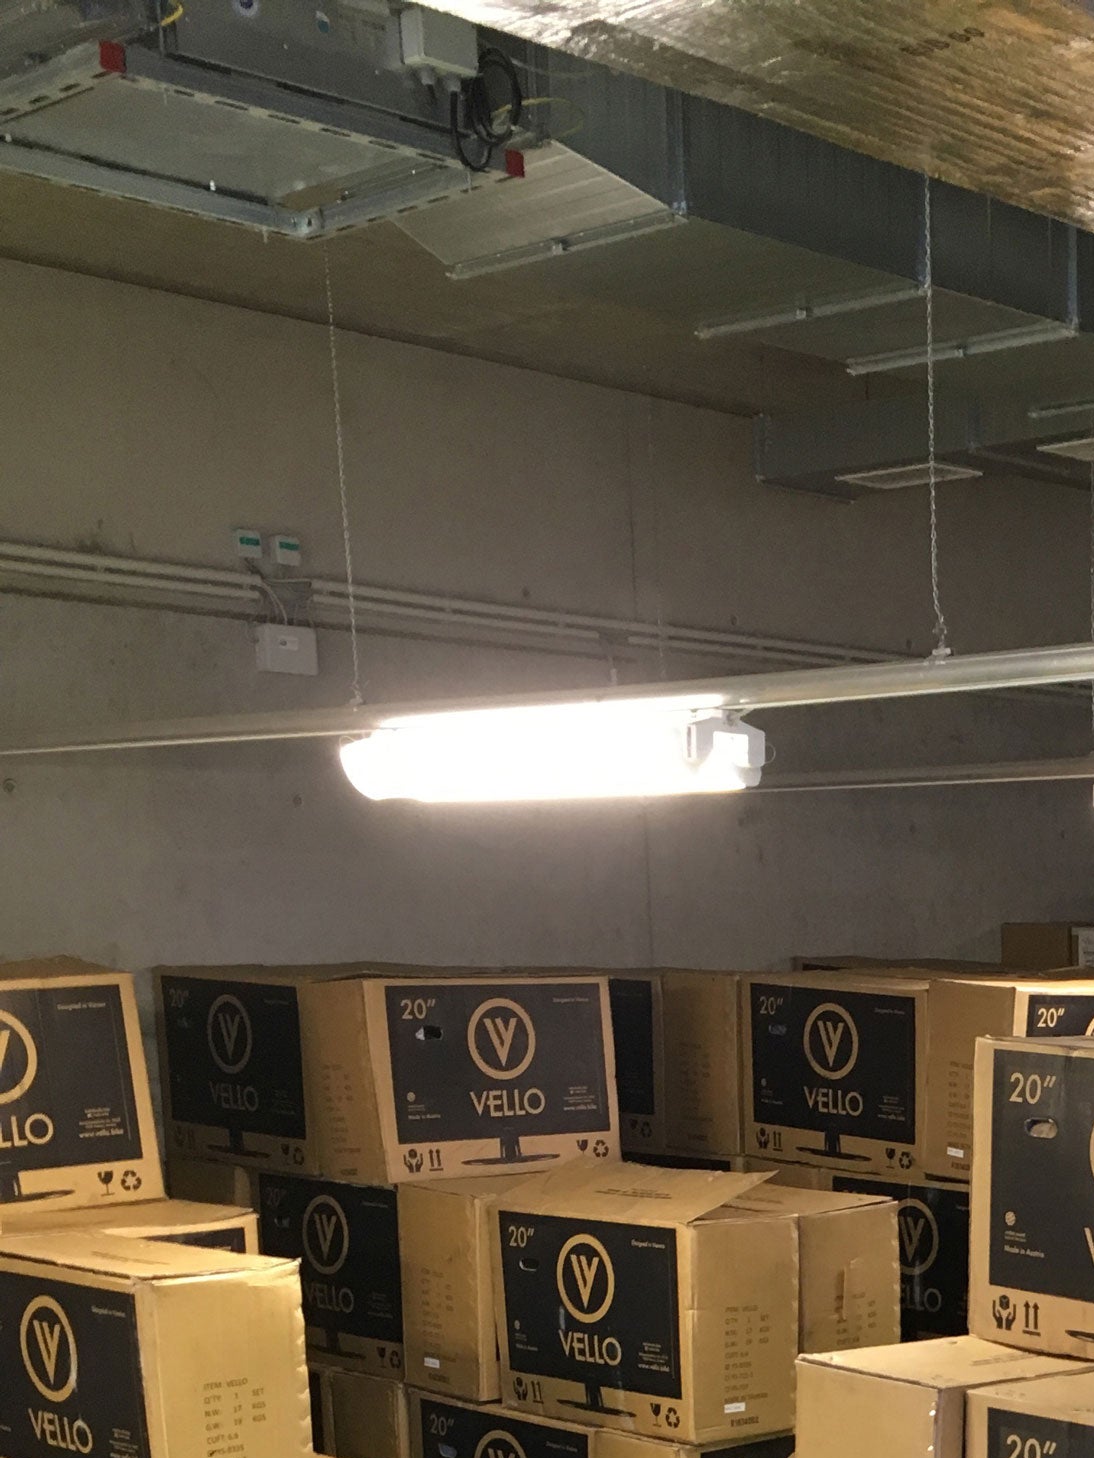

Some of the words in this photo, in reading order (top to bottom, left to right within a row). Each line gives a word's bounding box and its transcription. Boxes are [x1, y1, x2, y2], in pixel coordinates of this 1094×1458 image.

[401, 999, 435, 1020] 20"
[760, 996, 783, 1015] 20"
[1037, 1008, 1065, 1028] 20"
[470, 1087, 545, 1117] VELLO
[804, 1085, 863, 1117] VELLO
[1010, 1071, 1056, 1105] 20"
[508, 1225, 534, 1249] 20"
[558, 1328, 622, 1367] VELLO
[28, 1407, 93, 1454] VELLO
